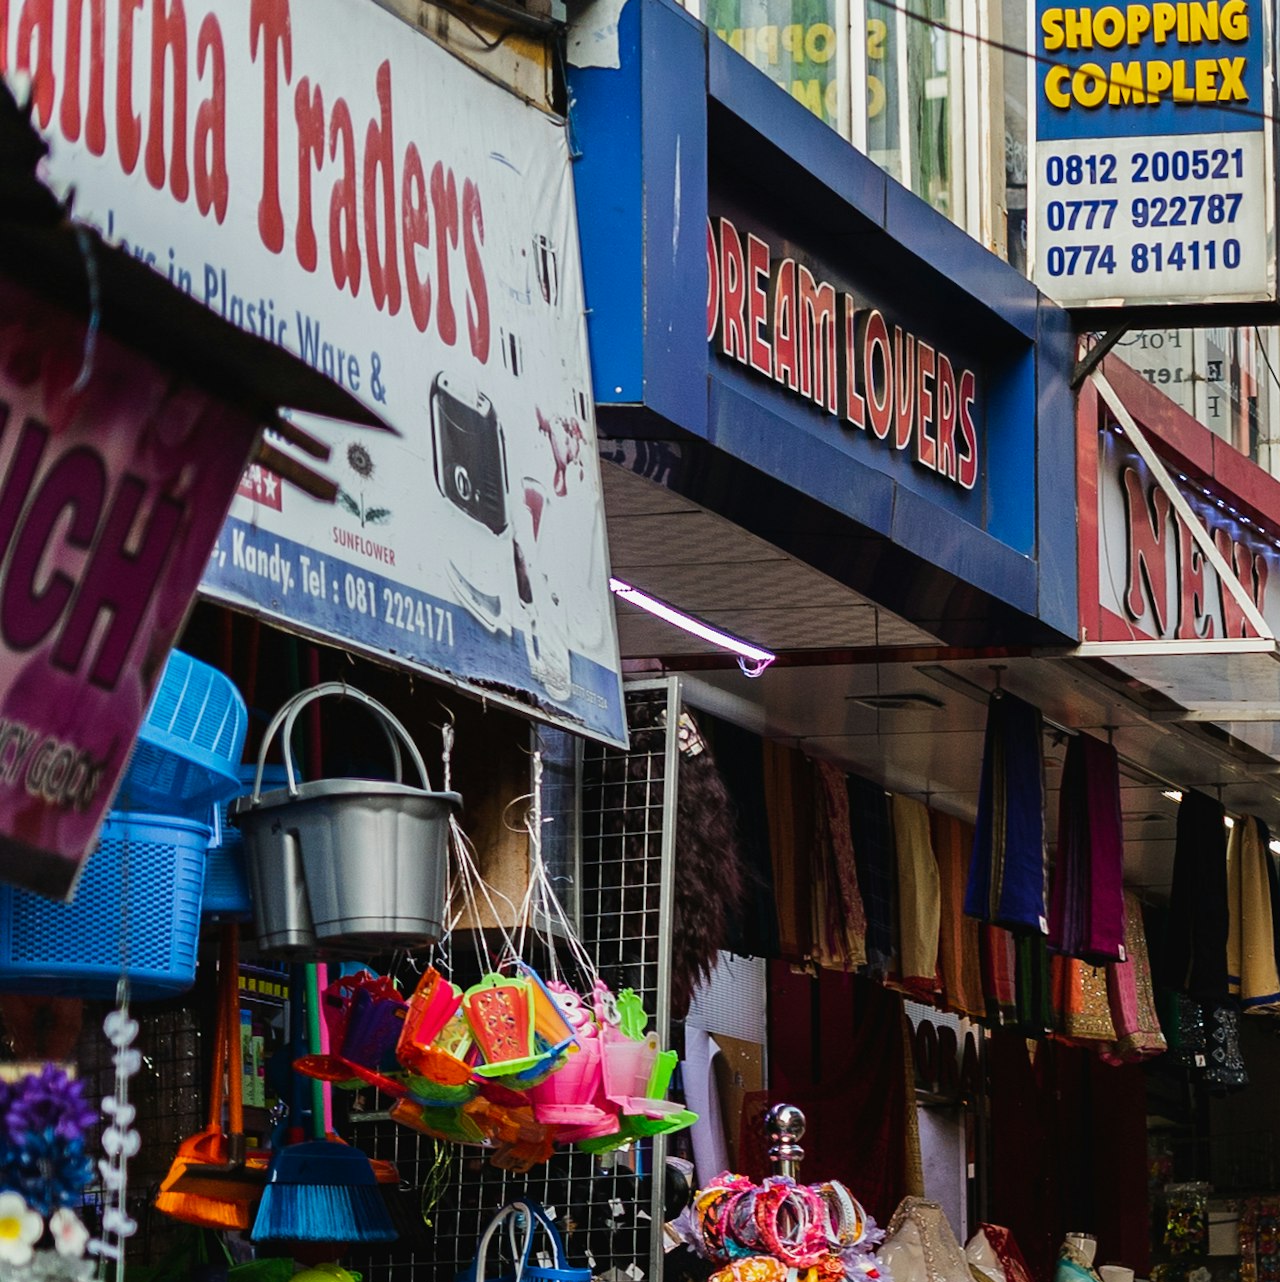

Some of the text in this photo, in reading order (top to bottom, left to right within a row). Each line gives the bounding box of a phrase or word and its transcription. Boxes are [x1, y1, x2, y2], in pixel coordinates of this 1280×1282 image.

[1041, 0, 1249, 50] SHOPPING
[1044, 57, 1249, 109] COMPLEX
[0, 0, 490, 365] antha Traders
[1047, 148, 1244, 186] 0812 200521
[1047, 194, 1243, 231] 0777 922787
[1047, 239, 1240, 277] 0774 814110
[298, 311, 361, 391] Ware
[370, 352, 386, 405] &
[845, 293, 978, 490] LOVERS
[333, 526, 397, 567] SUNFLOWER
[233, 529, 454, 648] Kandy. Tel 081 2224171
